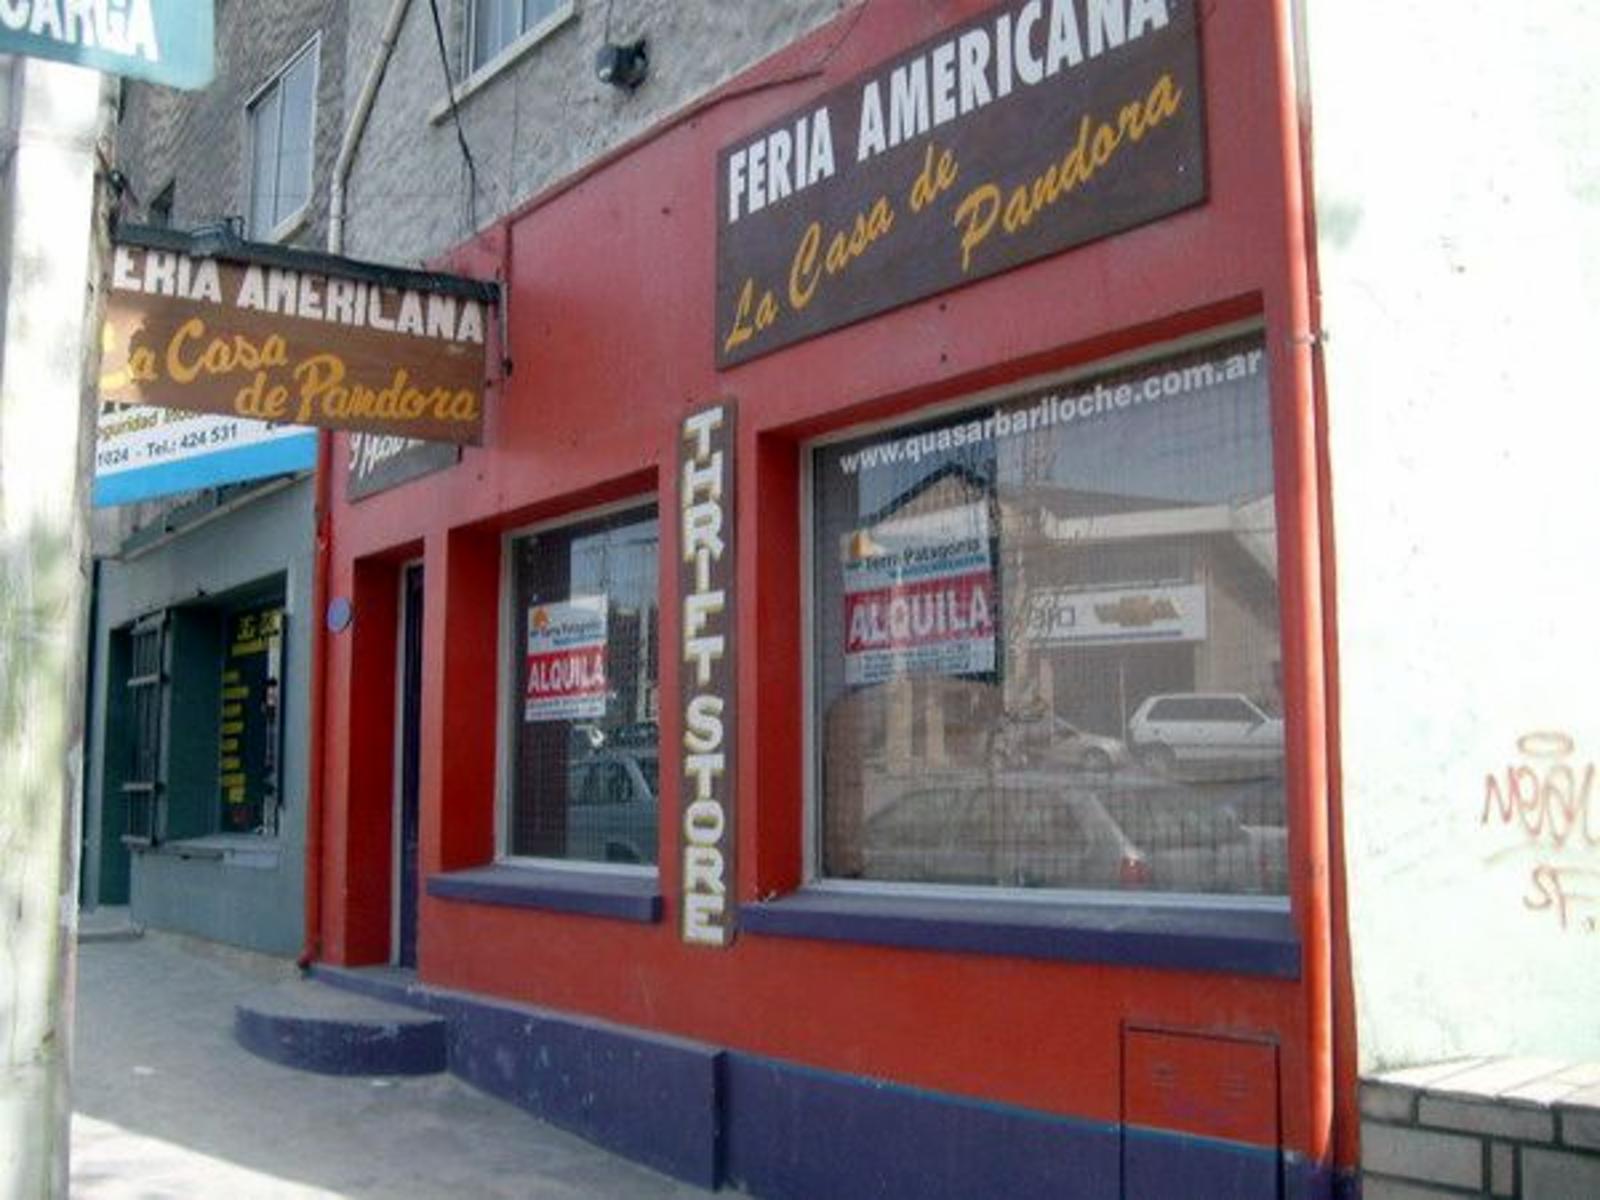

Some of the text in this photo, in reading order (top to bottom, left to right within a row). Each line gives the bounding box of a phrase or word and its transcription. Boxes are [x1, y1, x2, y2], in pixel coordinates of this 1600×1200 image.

[728, 106, 835, 224] FERIA
[954, 70, 1183, 273] Pandora
[112, 246, 221, 304] ERIA
[724, 144, 958, 352] La Casa de
[167, 317, 288, 384] Casa
[234, 354, 480, 424] de Pandora
[840, 350, 1263, 475] www.quasarbariloche.com.ar
[684, 406, 725, 688] THRIFT
[850, 584, 992, 642] ALQUILA
[528, 653, 605, 694] ALQUILA
[684, 694, 726, 944] STORE
